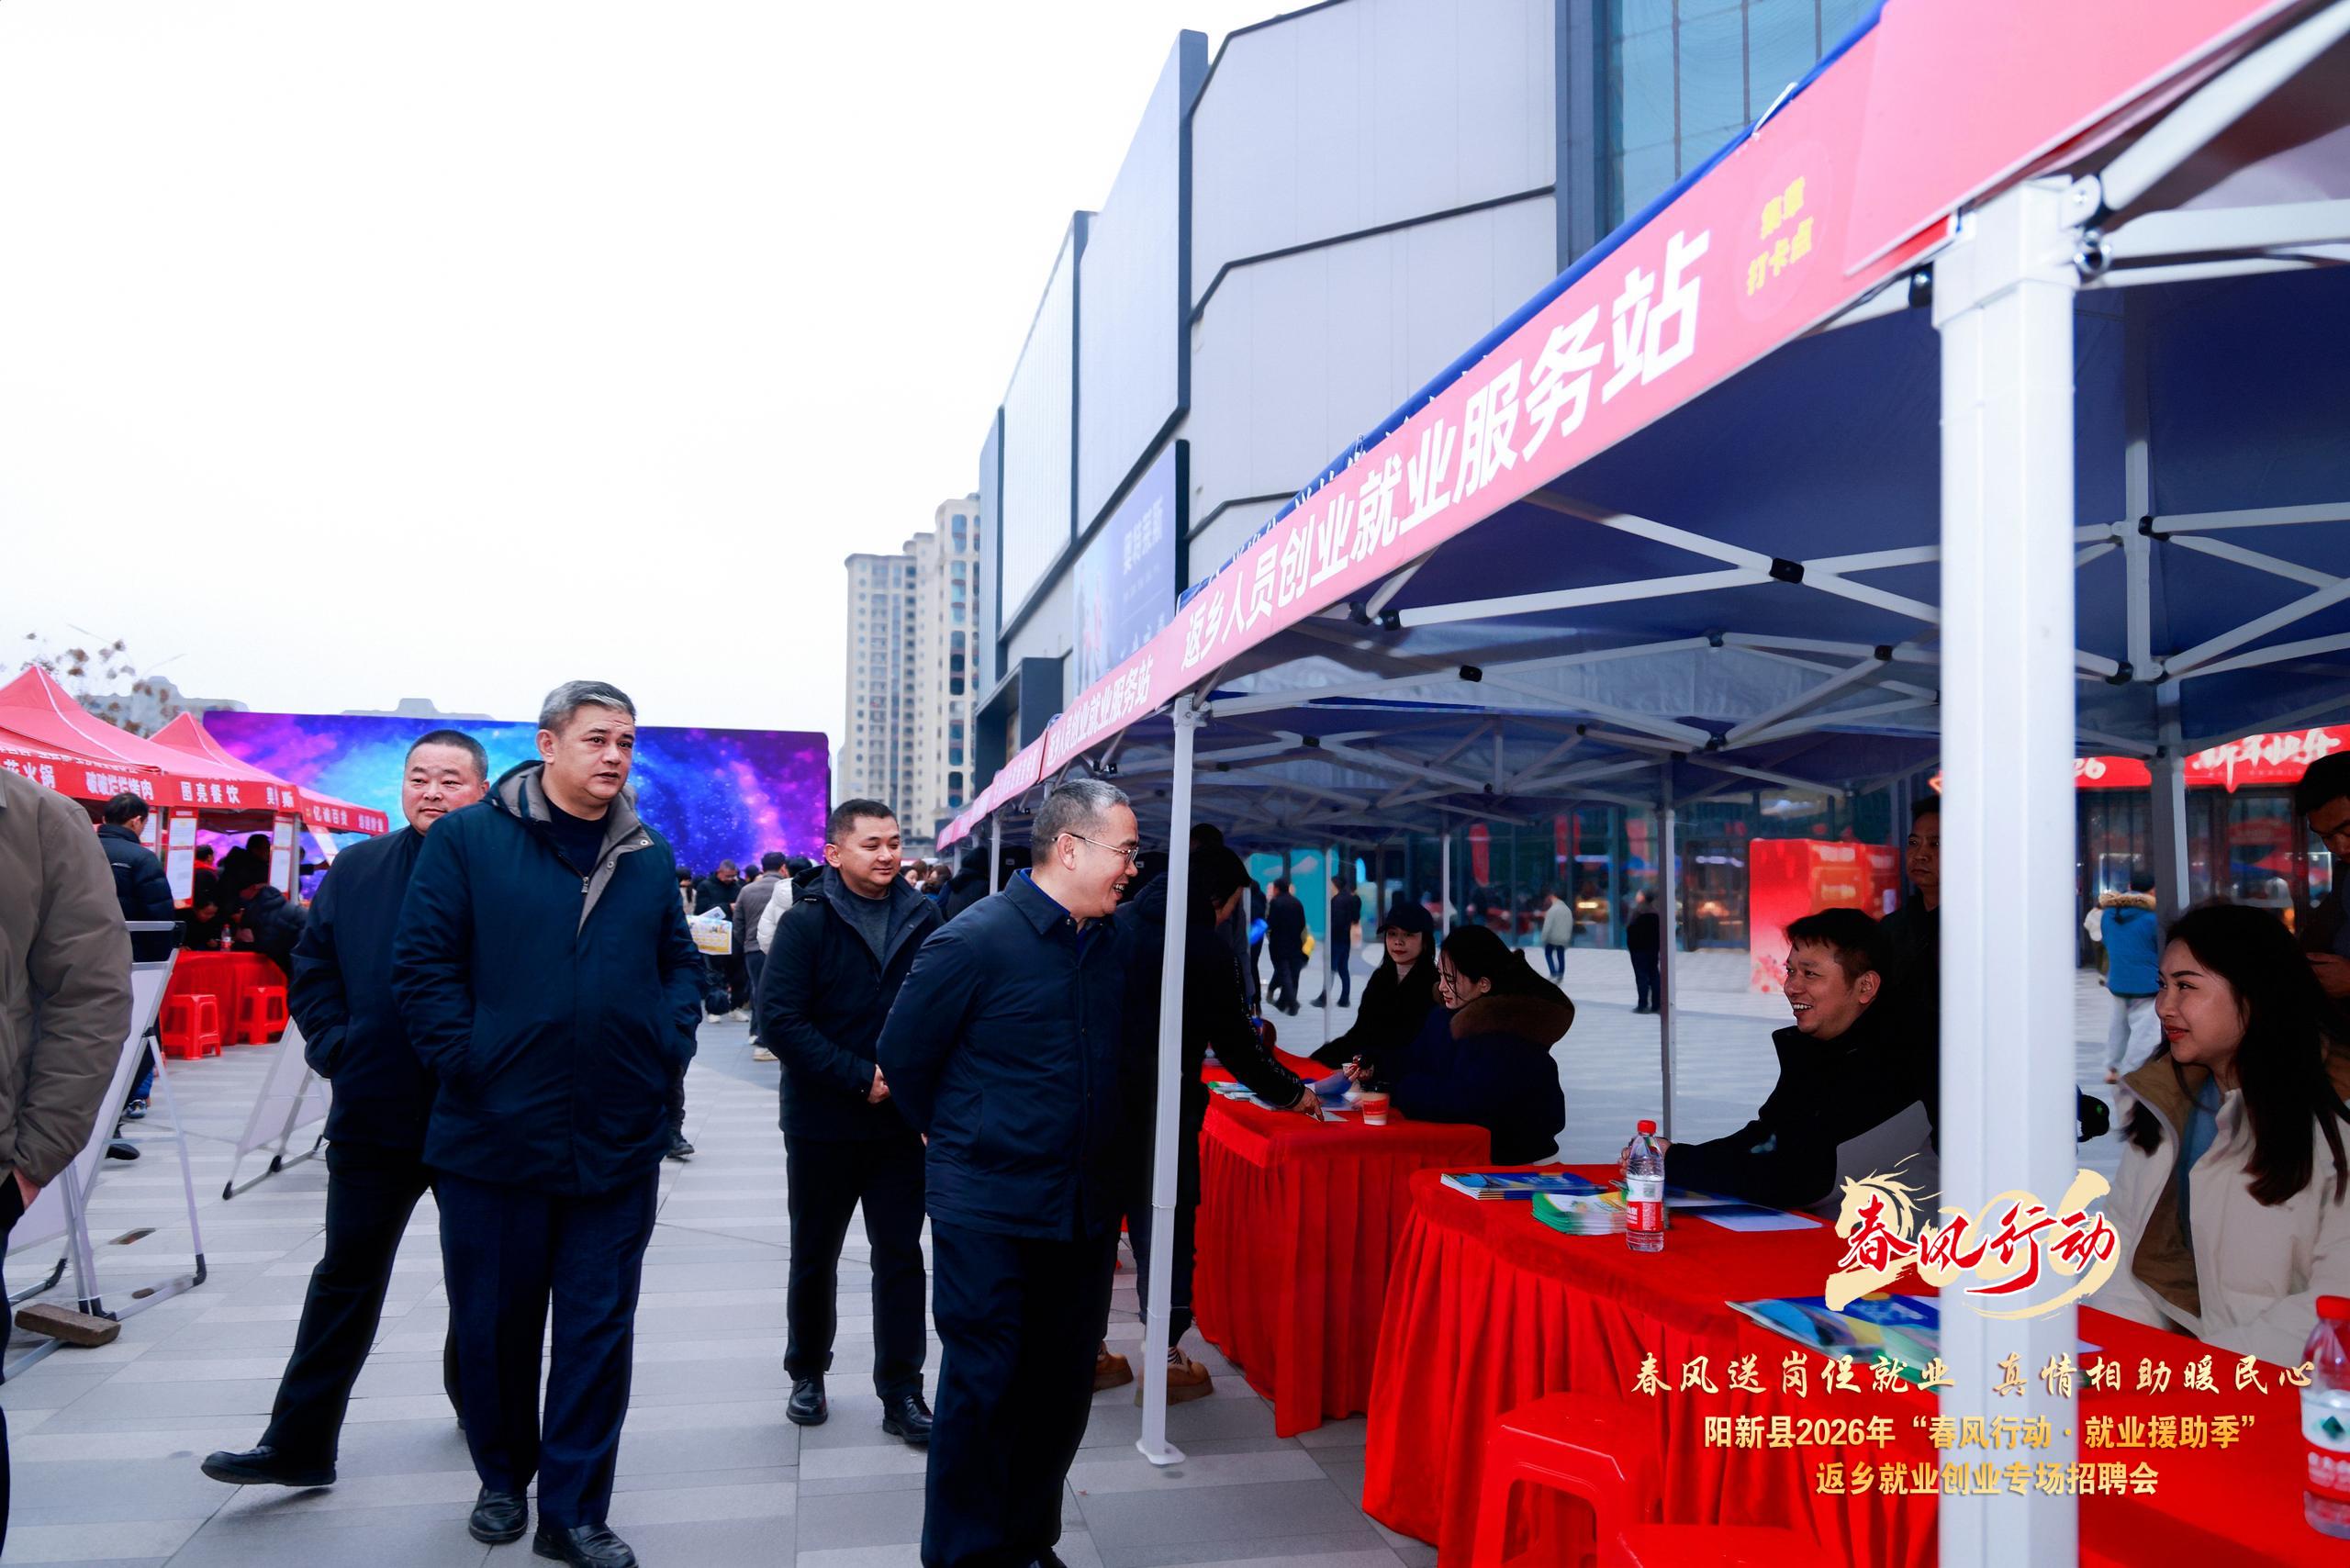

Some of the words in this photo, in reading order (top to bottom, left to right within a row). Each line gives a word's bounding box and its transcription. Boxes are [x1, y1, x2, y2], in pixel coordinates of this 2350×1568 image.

[1181, 230, 1710, 673] 返乡人员创业就业服务站
